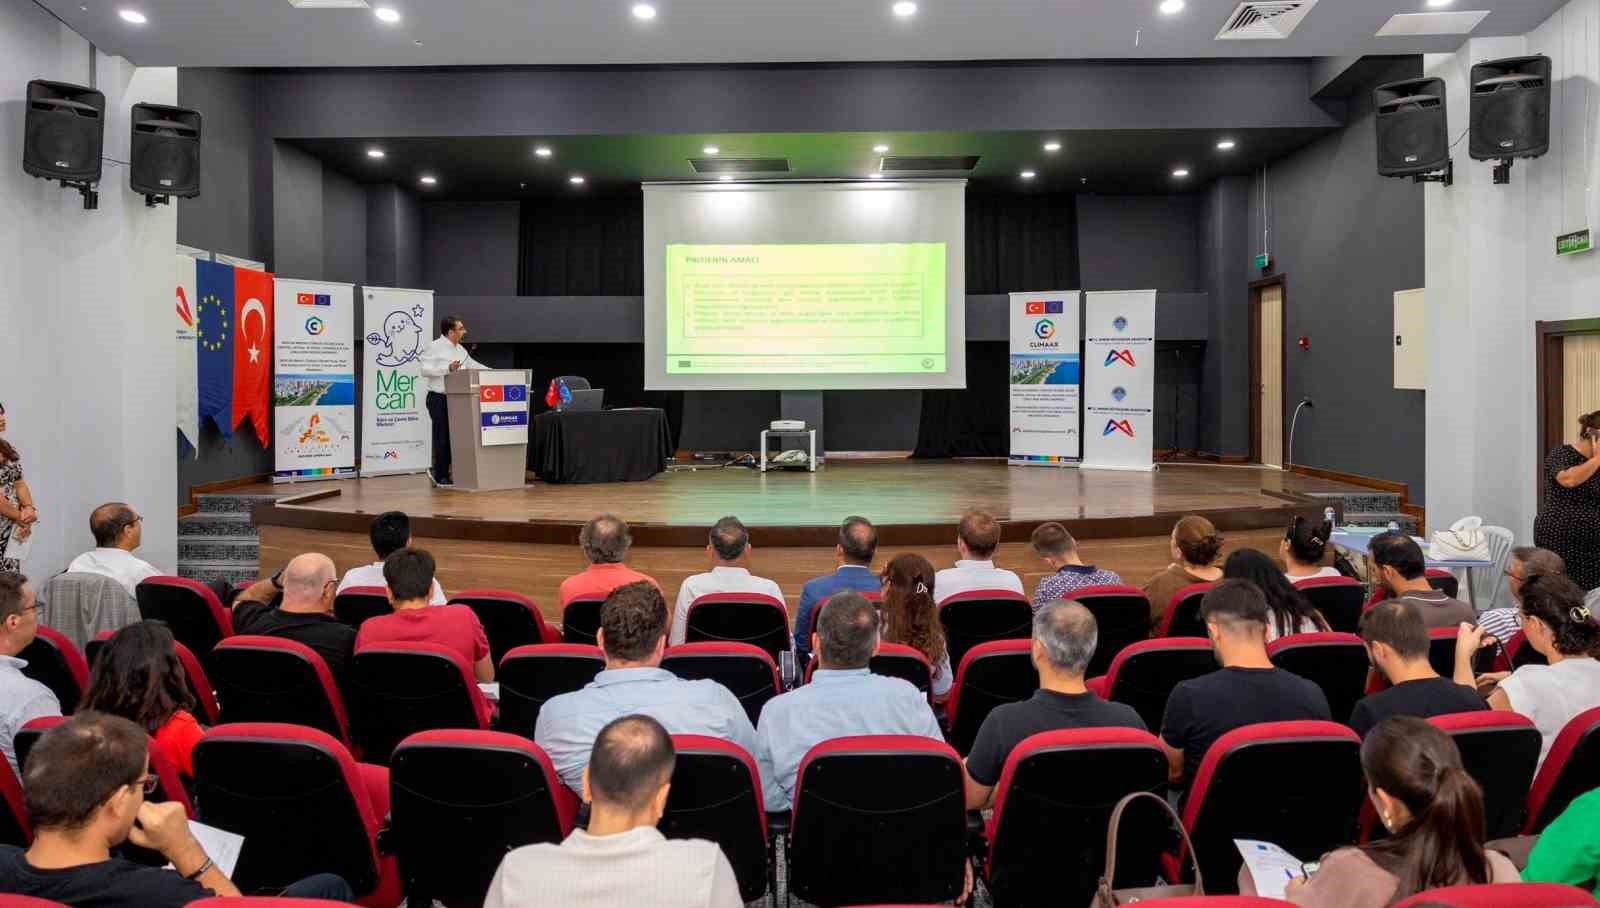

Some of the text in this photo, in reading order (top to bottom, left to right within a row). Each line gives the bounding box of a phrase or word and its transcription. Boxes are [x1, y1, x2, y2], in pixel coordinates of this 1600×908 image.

[310, 321, 318, 331] C
[1040, 324, 1049, 334] C
[376, 369, 418, 393] Mer
[375, 392, 416, 410] can
